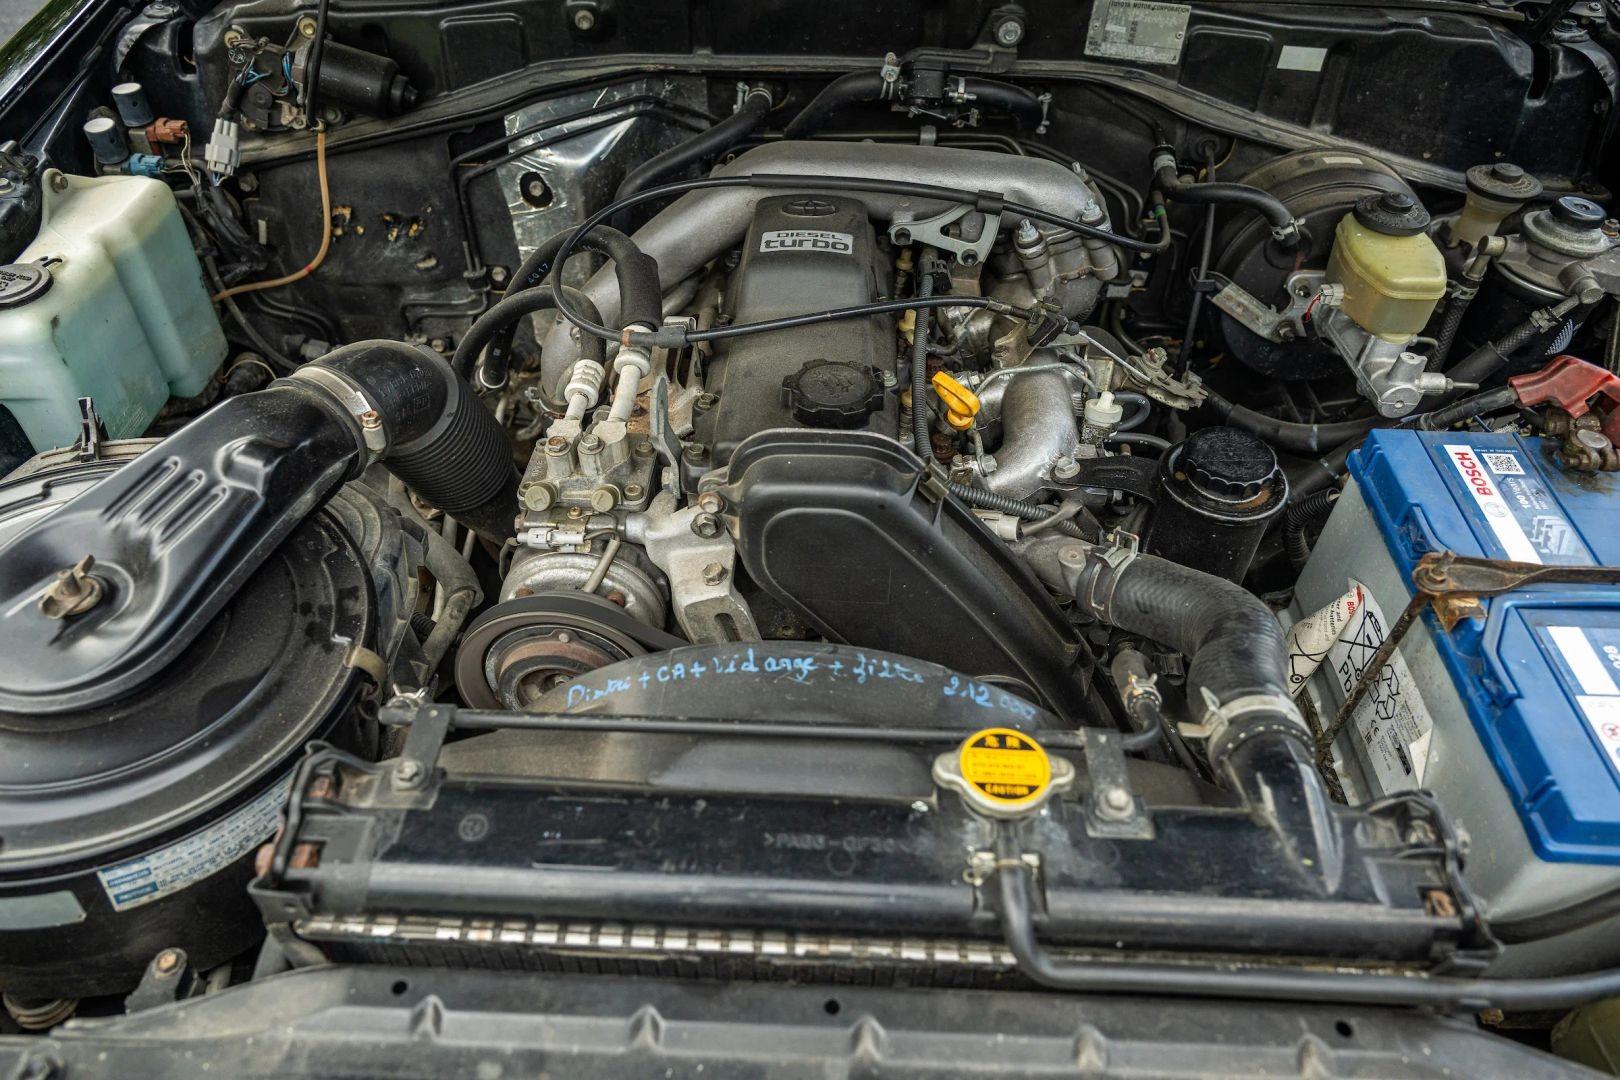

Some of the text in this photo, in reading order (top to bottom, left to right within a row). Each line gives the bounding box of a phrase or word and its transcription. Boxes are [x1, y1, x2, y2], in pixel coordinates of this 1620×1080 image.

[764, 239, 850, 252] turbo
[777, 232, 843, 241] DIESEL
[1454, 452, 1493, 497] BOSCH
[1338, 661, 1353, 692] Pb
